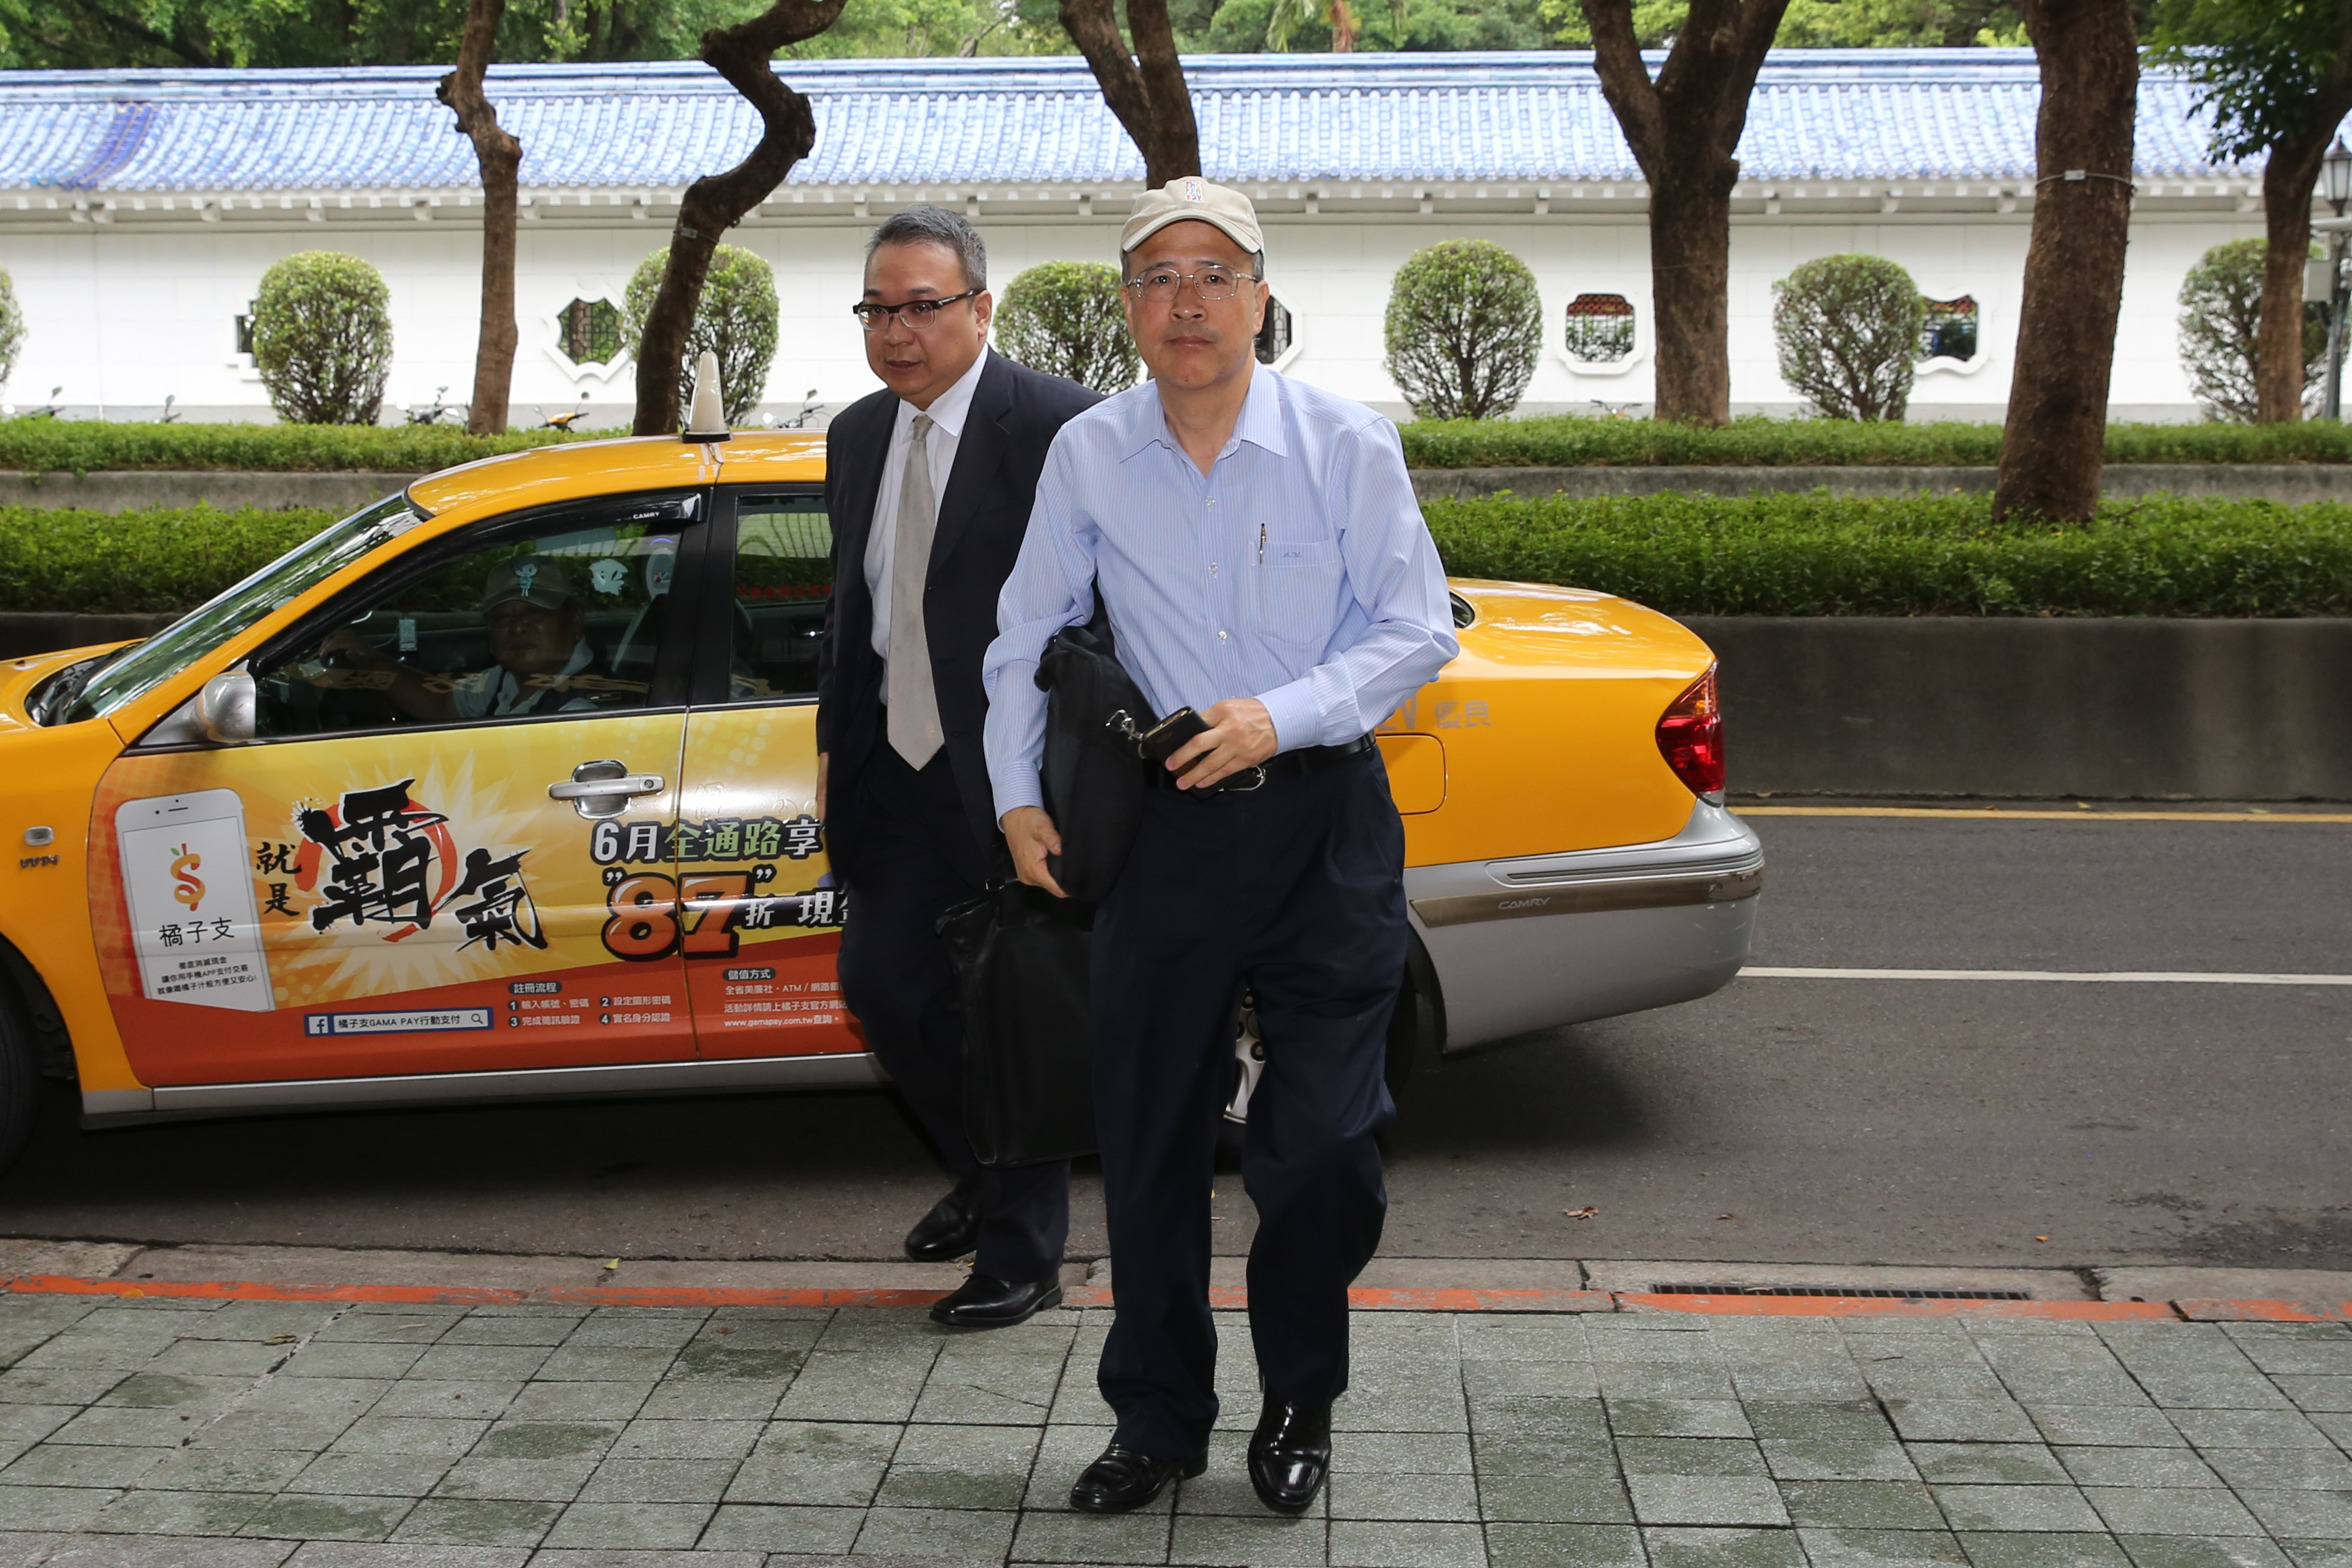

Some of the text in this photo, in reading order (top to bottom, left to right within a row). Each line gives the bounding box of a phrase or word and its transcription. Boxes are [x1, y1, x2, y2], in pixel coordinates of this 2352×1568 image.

[594, 817, 822, 861] 6月全通路享
[256, 841, 303, 917] 就是
[1498, 896, 1551, 910] CAMRY
[159, 917, 235, 947] 橘子支
[728, 969, 771, 980] 儲值方式
[514, 983, 557, 994] 註冊流程
